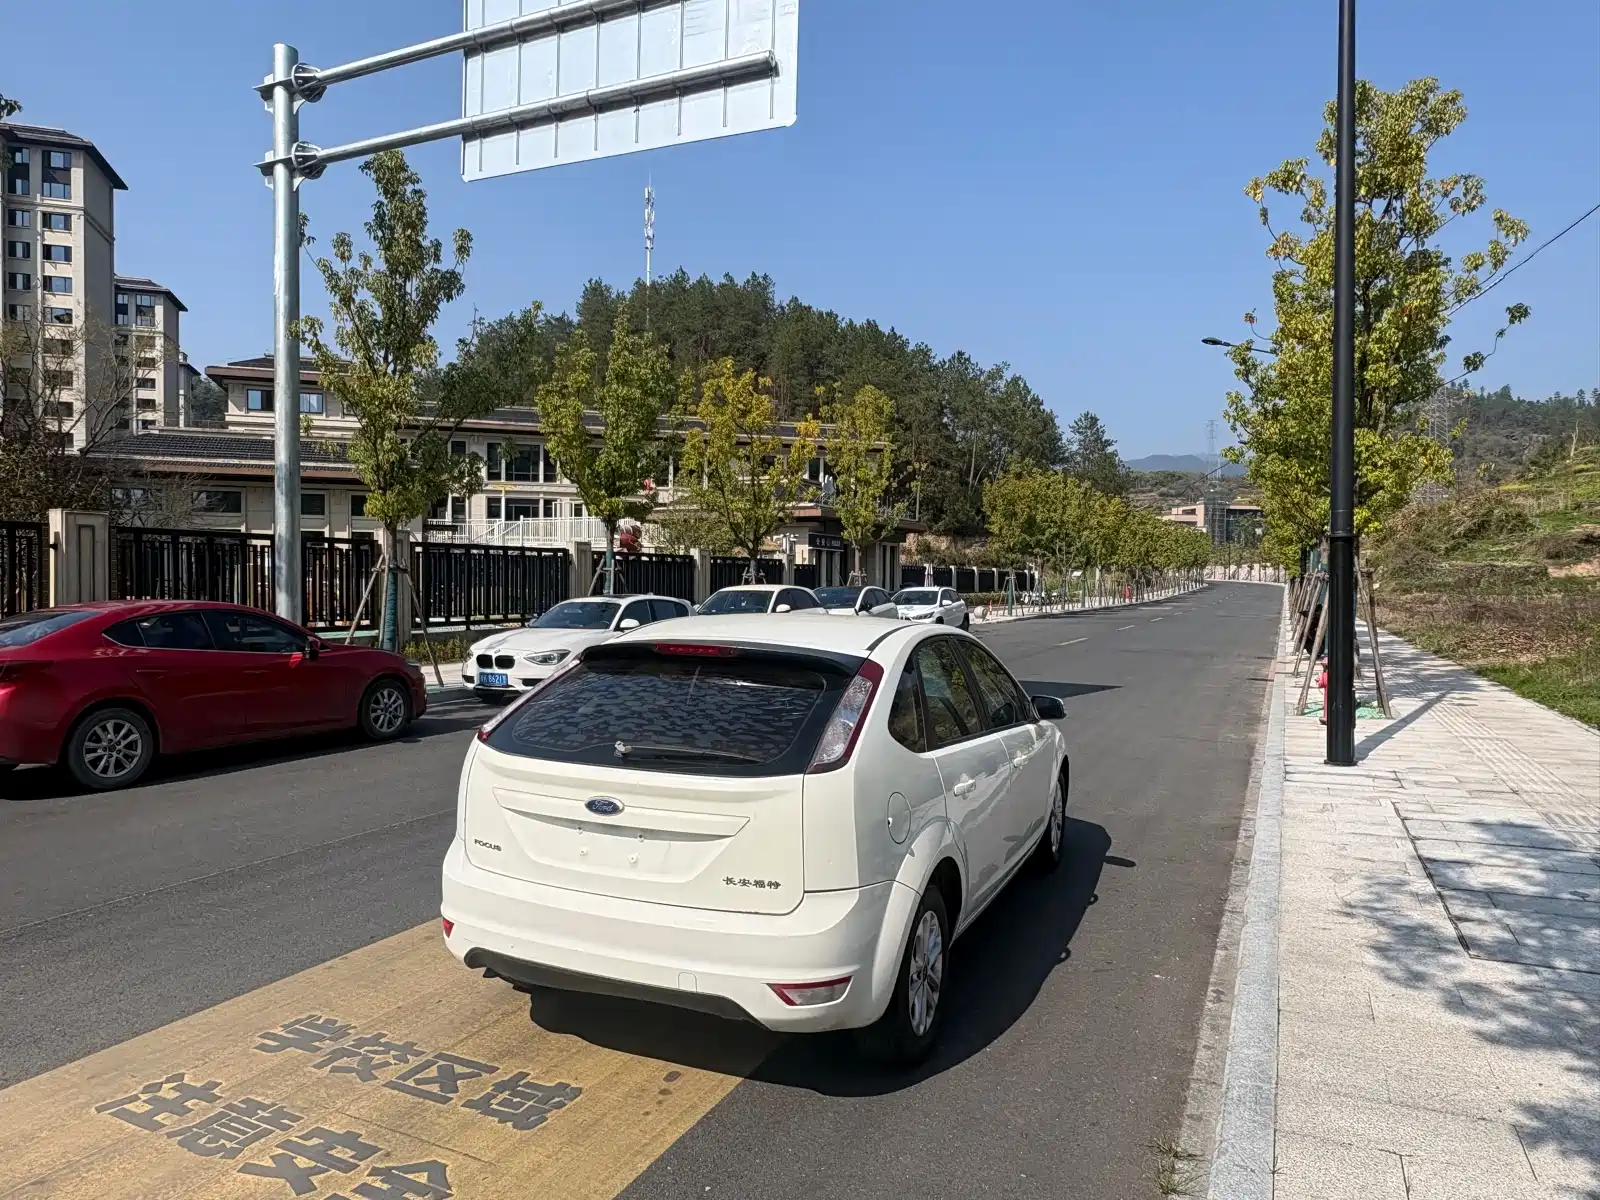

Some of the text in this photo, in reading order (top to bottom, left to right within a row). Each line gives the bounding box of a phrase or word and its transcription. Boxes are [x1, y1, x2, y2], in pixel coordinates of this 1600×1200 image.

[474, 838, 502, 852] FOCUS
[722, 875, 782, 890] 长安福特
[252, 1013, 583, 1132] 学校区域
